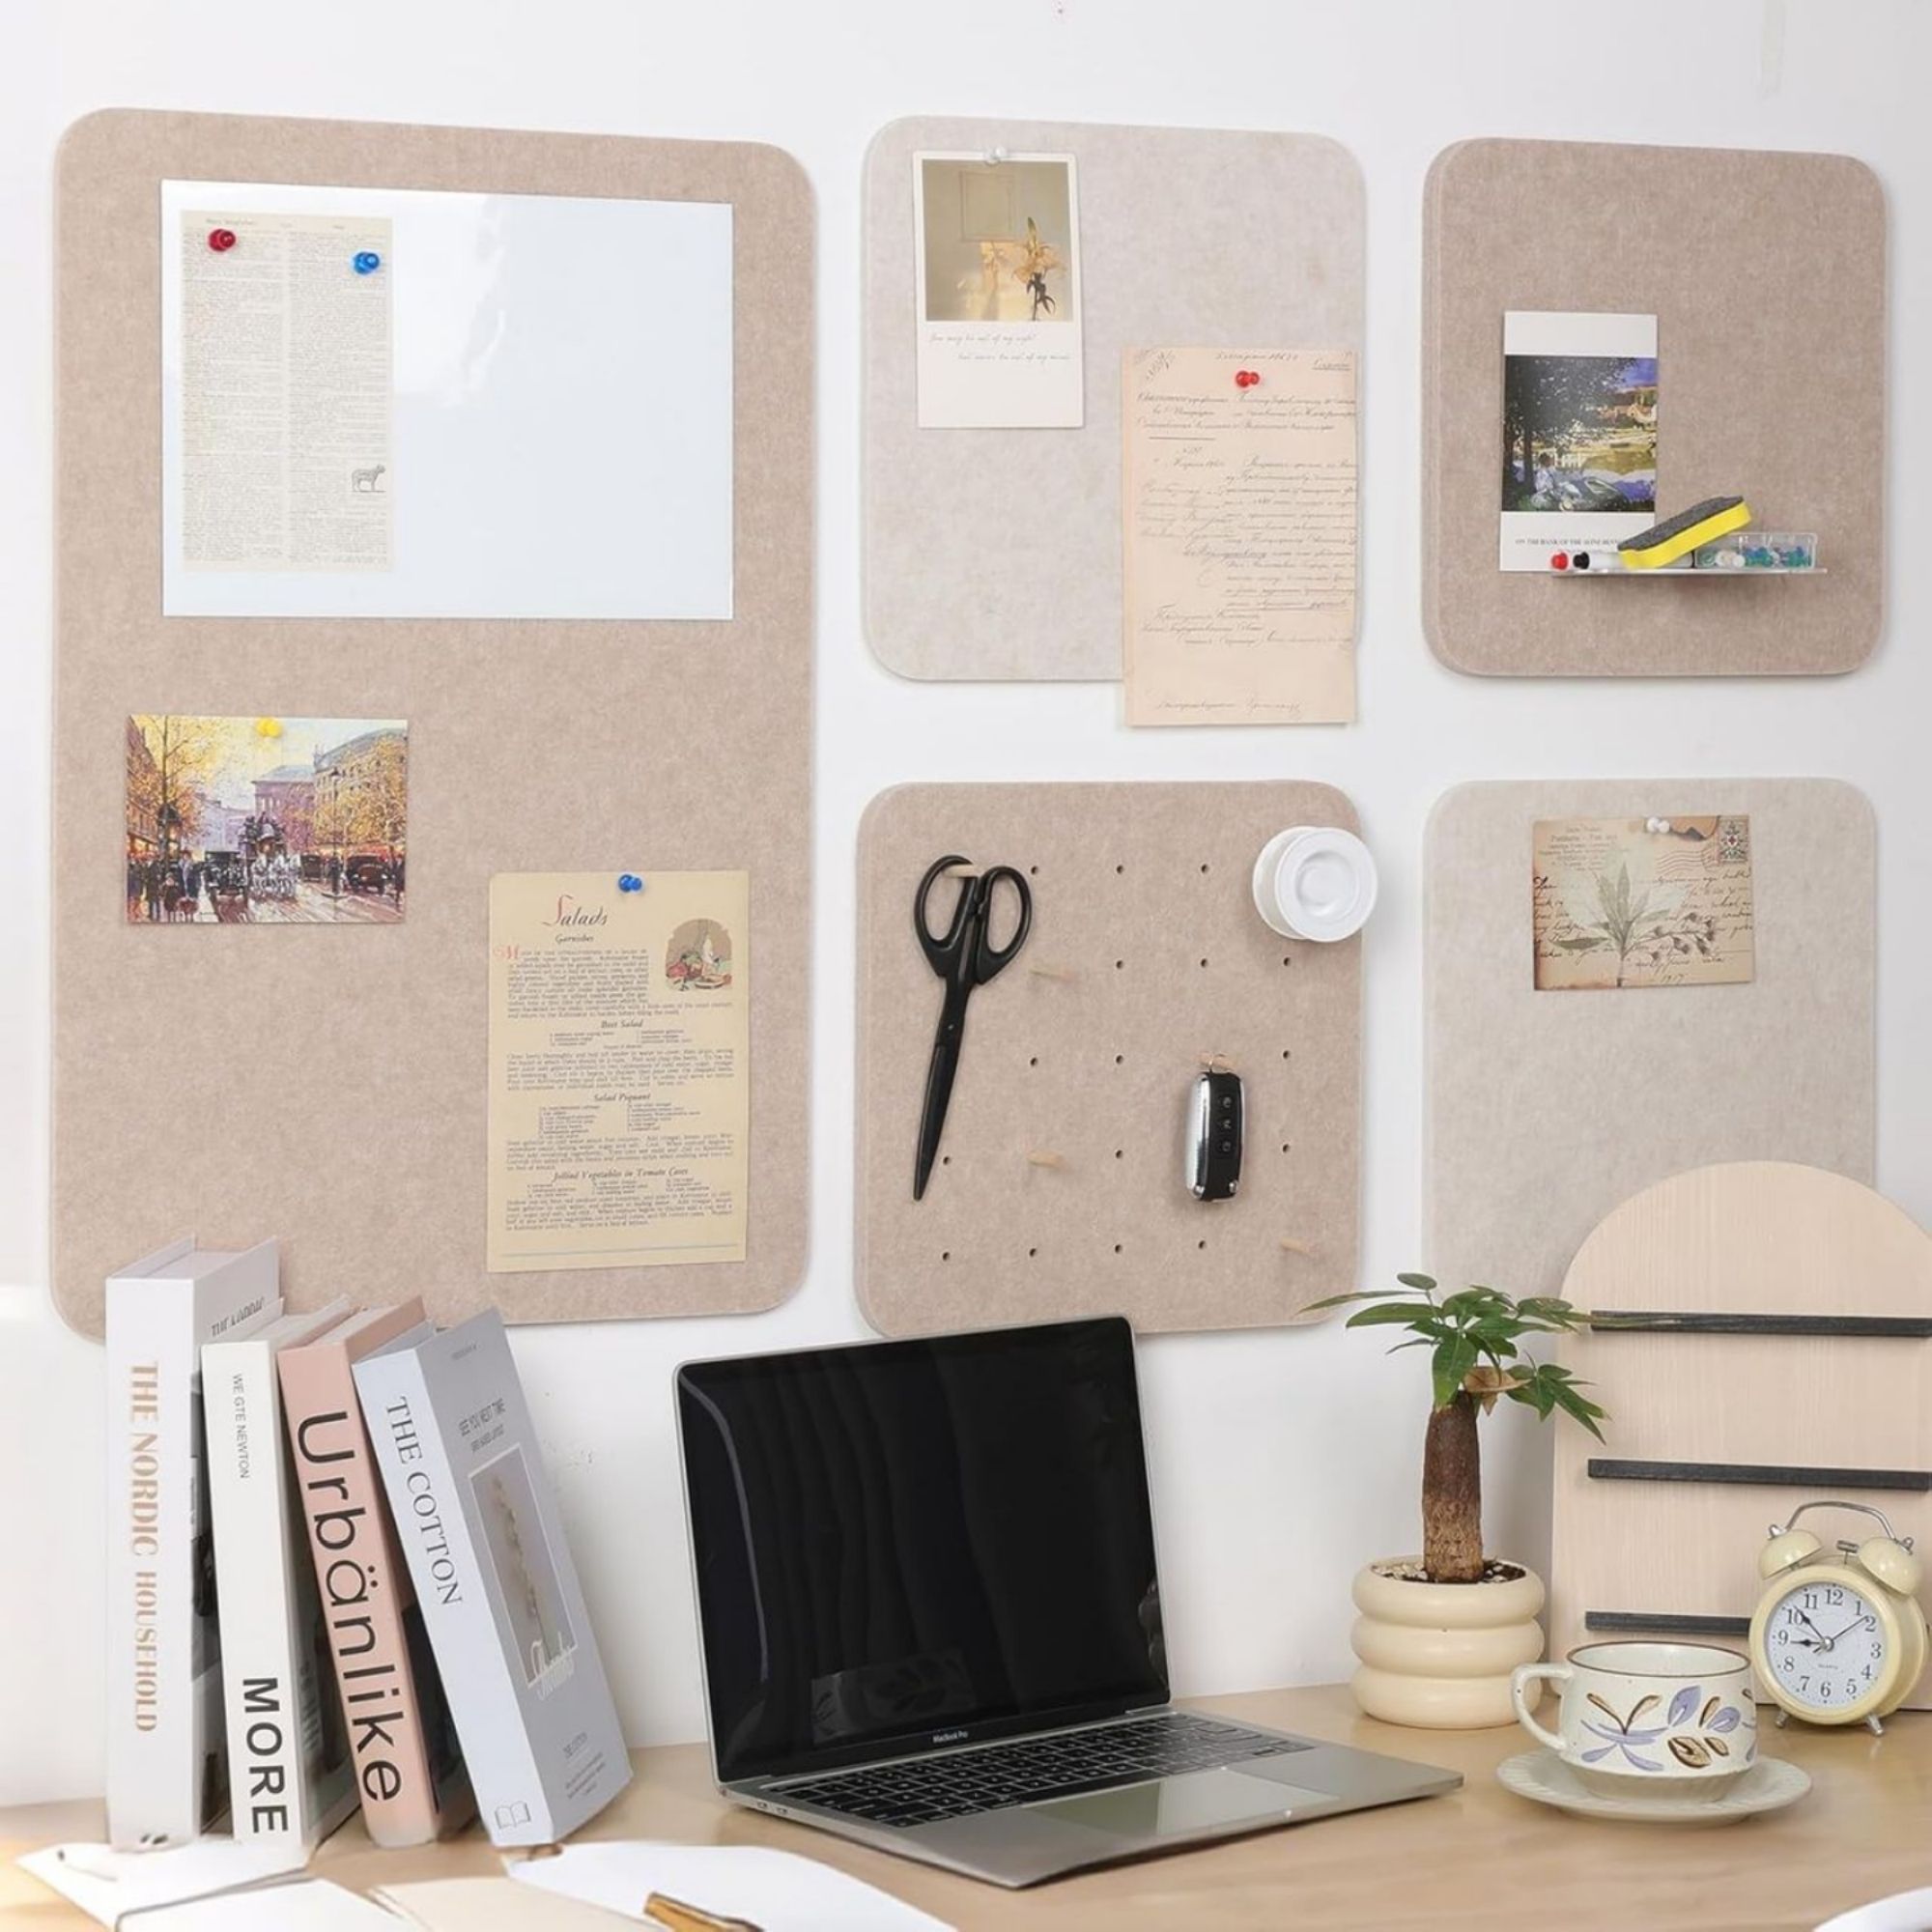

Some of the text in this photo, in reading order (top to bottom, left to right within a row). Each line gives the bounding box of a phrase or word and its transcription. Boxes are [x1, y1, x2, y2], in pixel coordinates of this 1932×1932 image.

[542, 894, 609, 927] Salads
[593, 1093, 616, 1102] Salad
[232, 1373, 245, 1393] WE
[129, 1363, 159, 1556] THE NORDIC
[237, 1424, 250, 1479] NEWTON
[386, 1396, 463, 1605] THE COTTON
[298, 1411, 404, 1801] Urbänlike
[1803, 1592, 1818, 1610] 11
[1825, 1588, 1844, 1606] 12
[1786, 1608, 1804, 1626] 10
[1854, 1600, 1862, 1616] 1
[1863, 1616, 1877, 1633] 2
[1777, 1630, 1789, 1646] 9
[135, 1571, 158, 1732] HOUSEHOLD
[1870, 1643, 1882, 1659] 3
[1783, 1657, 1795, 1672] 8
[1861, 1664, 1872, 1681] 4
[1799, 1676, 1811, 1692] 7
[1820, 1681, 1832, 1697] 6
[1845, 1679, 1858, 1694] 5
[242, 1677, 289, 1833] MORE
